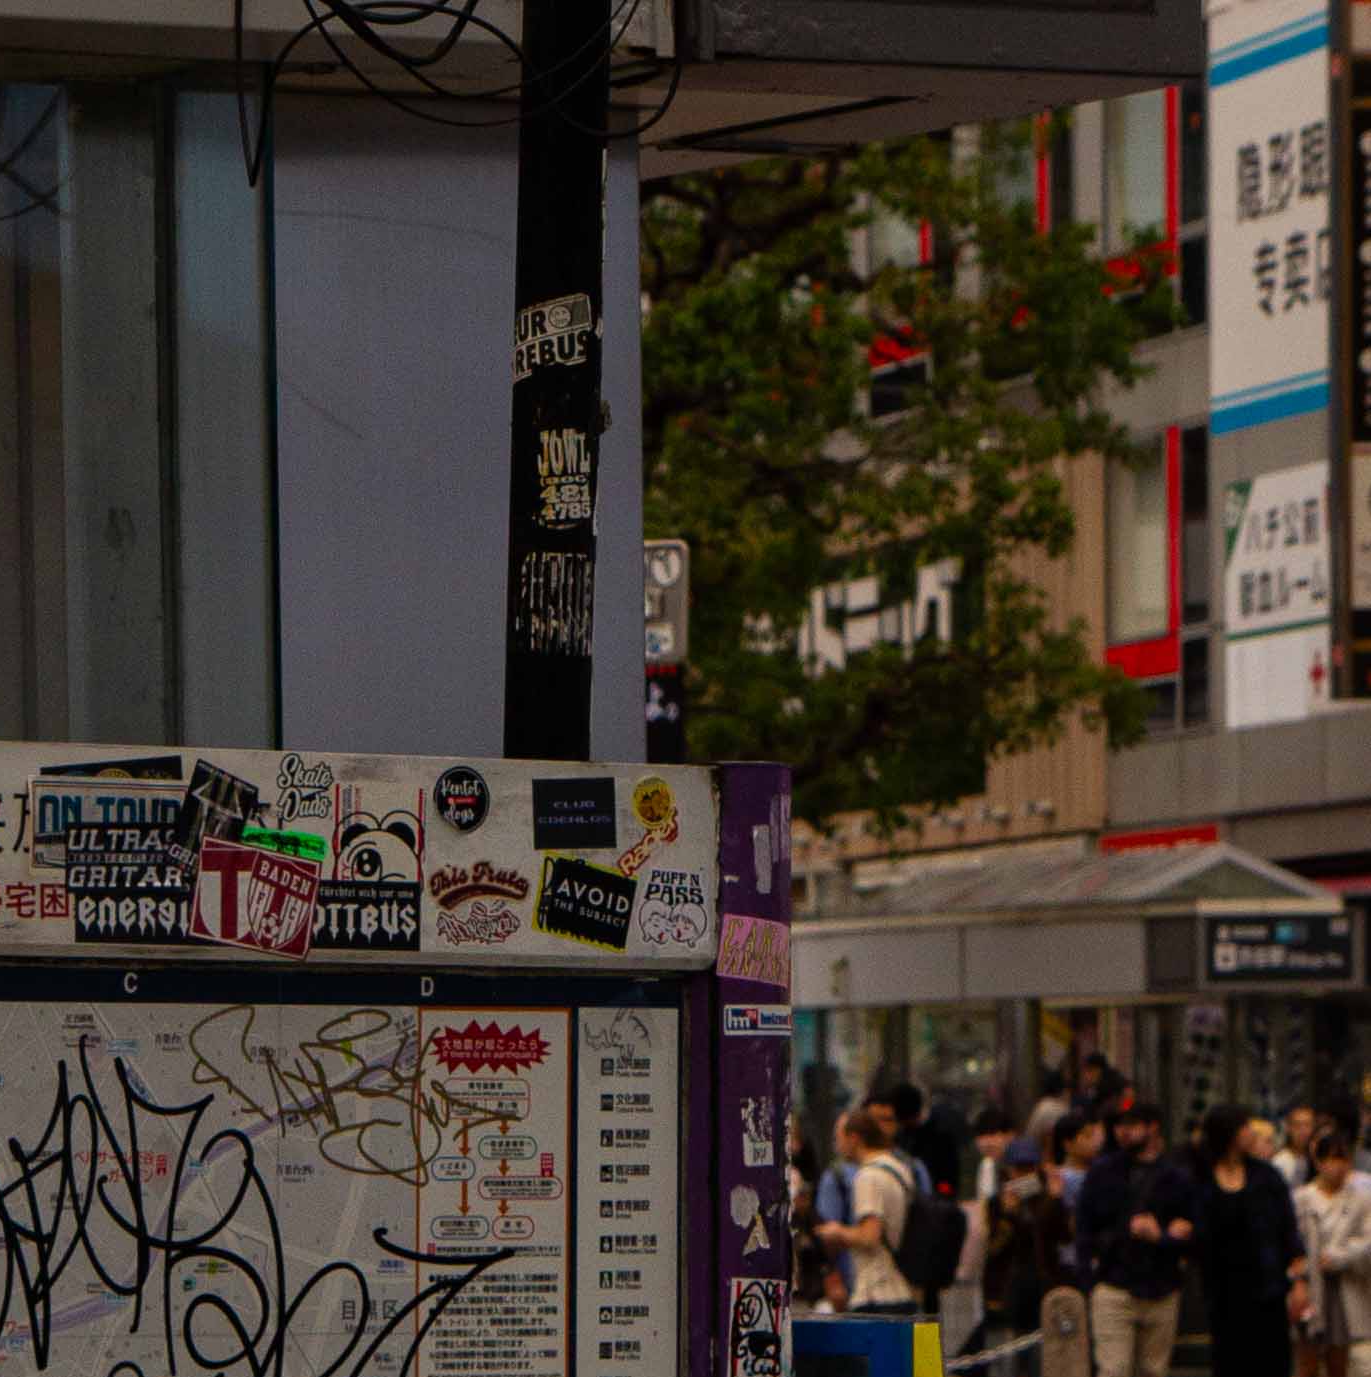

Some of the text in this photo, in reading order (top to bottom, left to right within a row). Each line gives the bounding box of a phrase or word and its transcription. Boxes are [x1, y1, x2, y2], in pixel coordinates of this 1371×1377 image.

[278, 753, 334, 789] Skate
[279, 787, 333, 822] Dads
[259, 860, 313, 897] BADEN
[651, 870, 700, 886] PUFF N
[556, 877, 630, 913] AVOID
[644, 884, 704, 905] PASS
[122, 973, 139, 994] C
[419, 978, 435, 998] D
